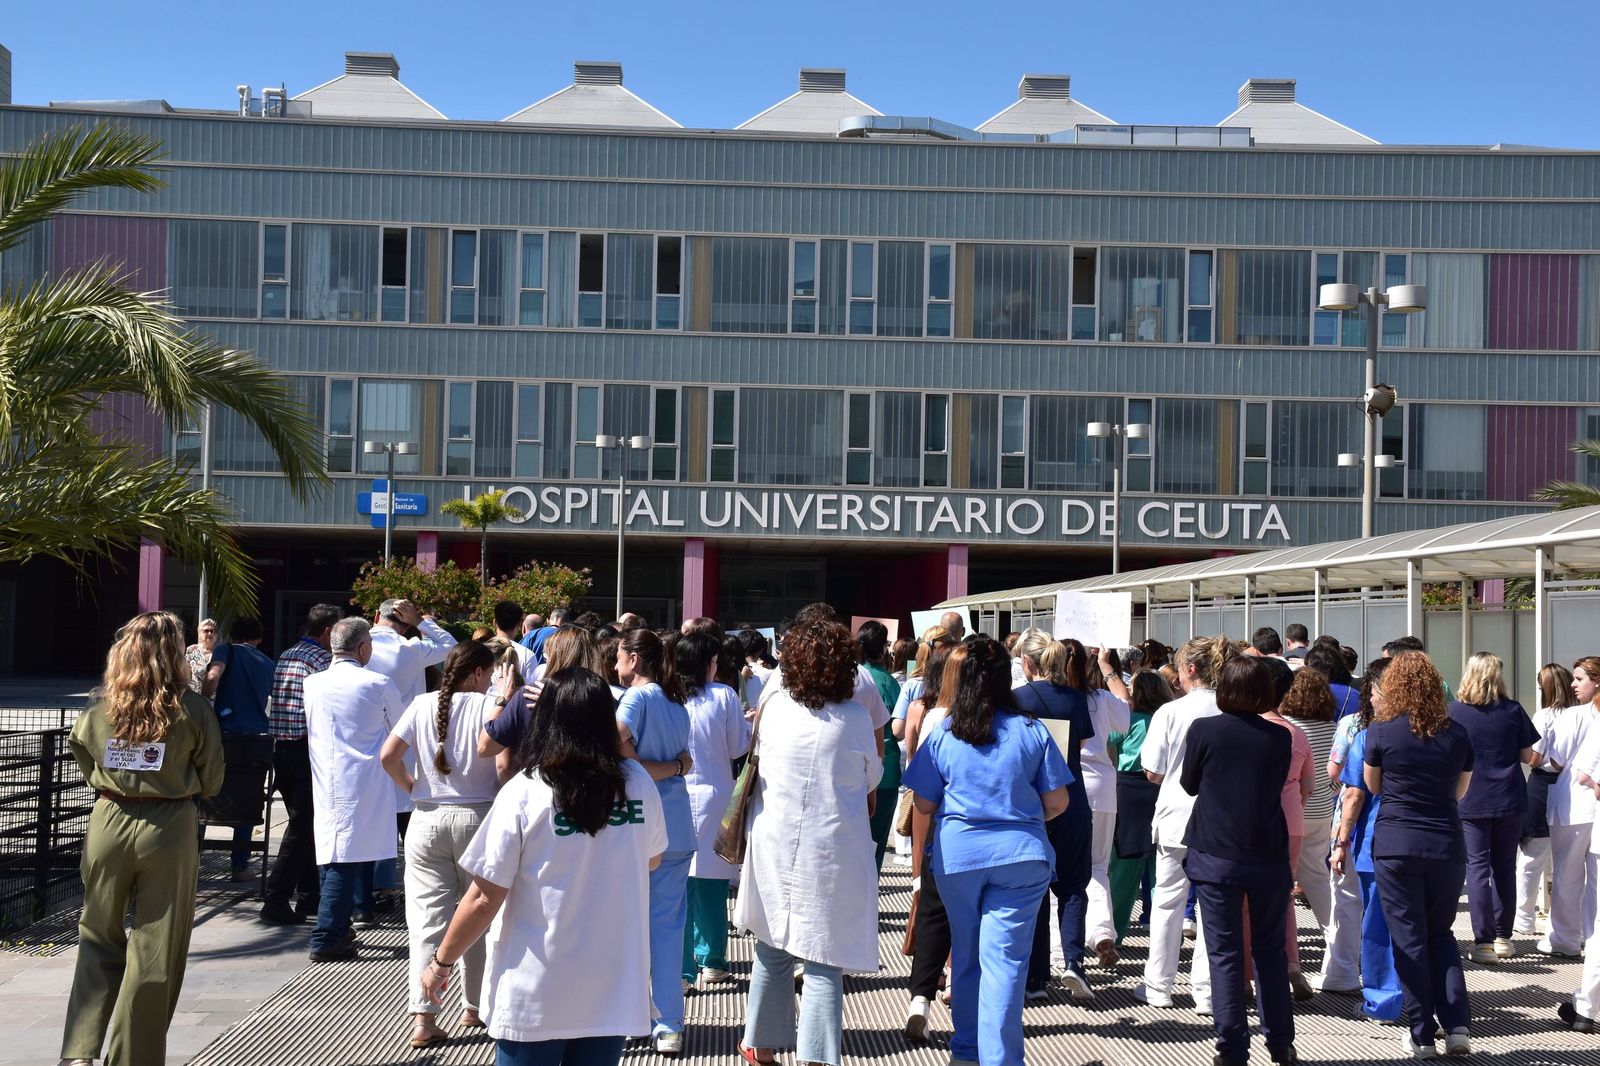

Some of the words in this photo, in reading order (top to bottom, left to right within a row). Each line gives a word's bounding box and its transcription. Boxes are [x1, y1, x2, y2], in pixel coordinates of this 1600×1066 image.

[395, 502, 417, 510] Sanitaria
[700, 491, 1044, 534] UNIVERSITARIO
[1062, 499, 1120, 536] DE
[1138, 502, 1291, 540] CEUTA
[554, 800, 644, 836] SSE
